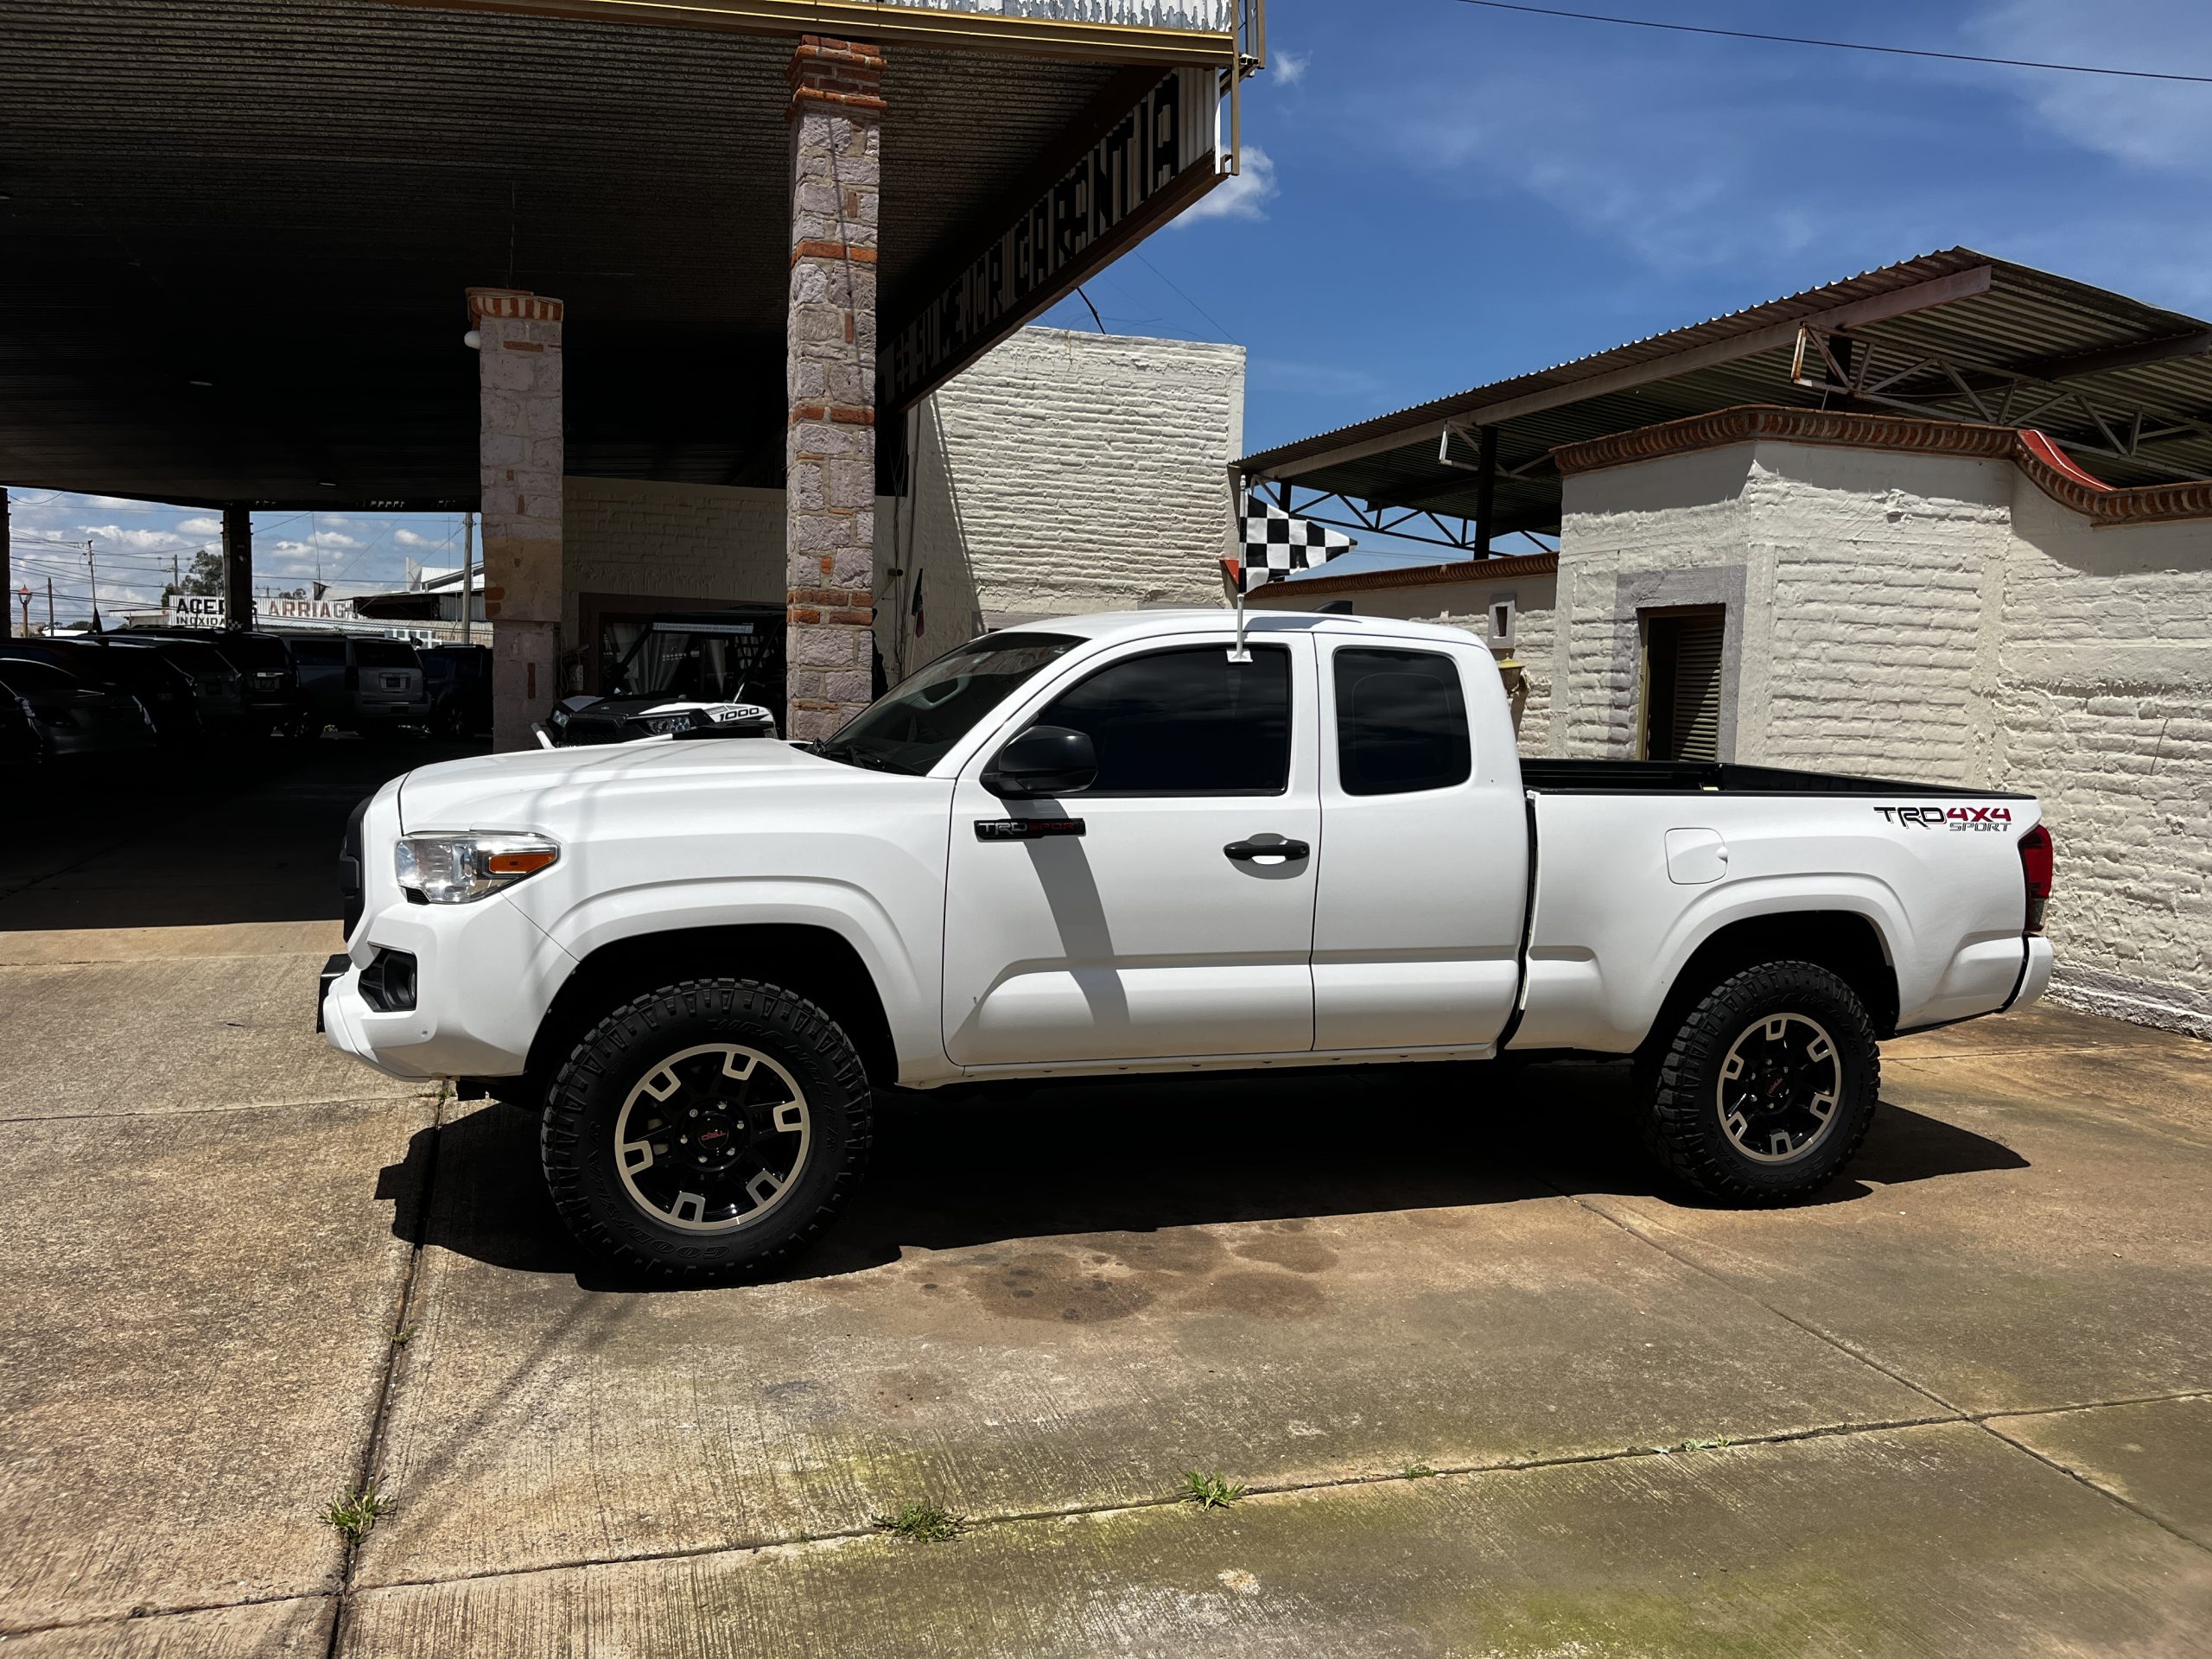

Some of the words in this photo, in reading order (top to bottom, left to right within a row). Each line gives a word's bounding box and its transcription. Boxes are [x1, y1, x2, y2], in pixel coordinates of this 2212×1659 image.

[1014, 73, 1180, 301] GARANTIA
[176, 598, 257, 616] ACE
[719, 708, 760, 721] 1000
[1873, 806, 1947, 829] TRD
[1946, 807, 2012, 823] 4X4
[978, 822, 1028, 836] TRD
[1949, 822, 2012, 832] SPORT
[587, 1120, 730, 1261] GOODYEAR
